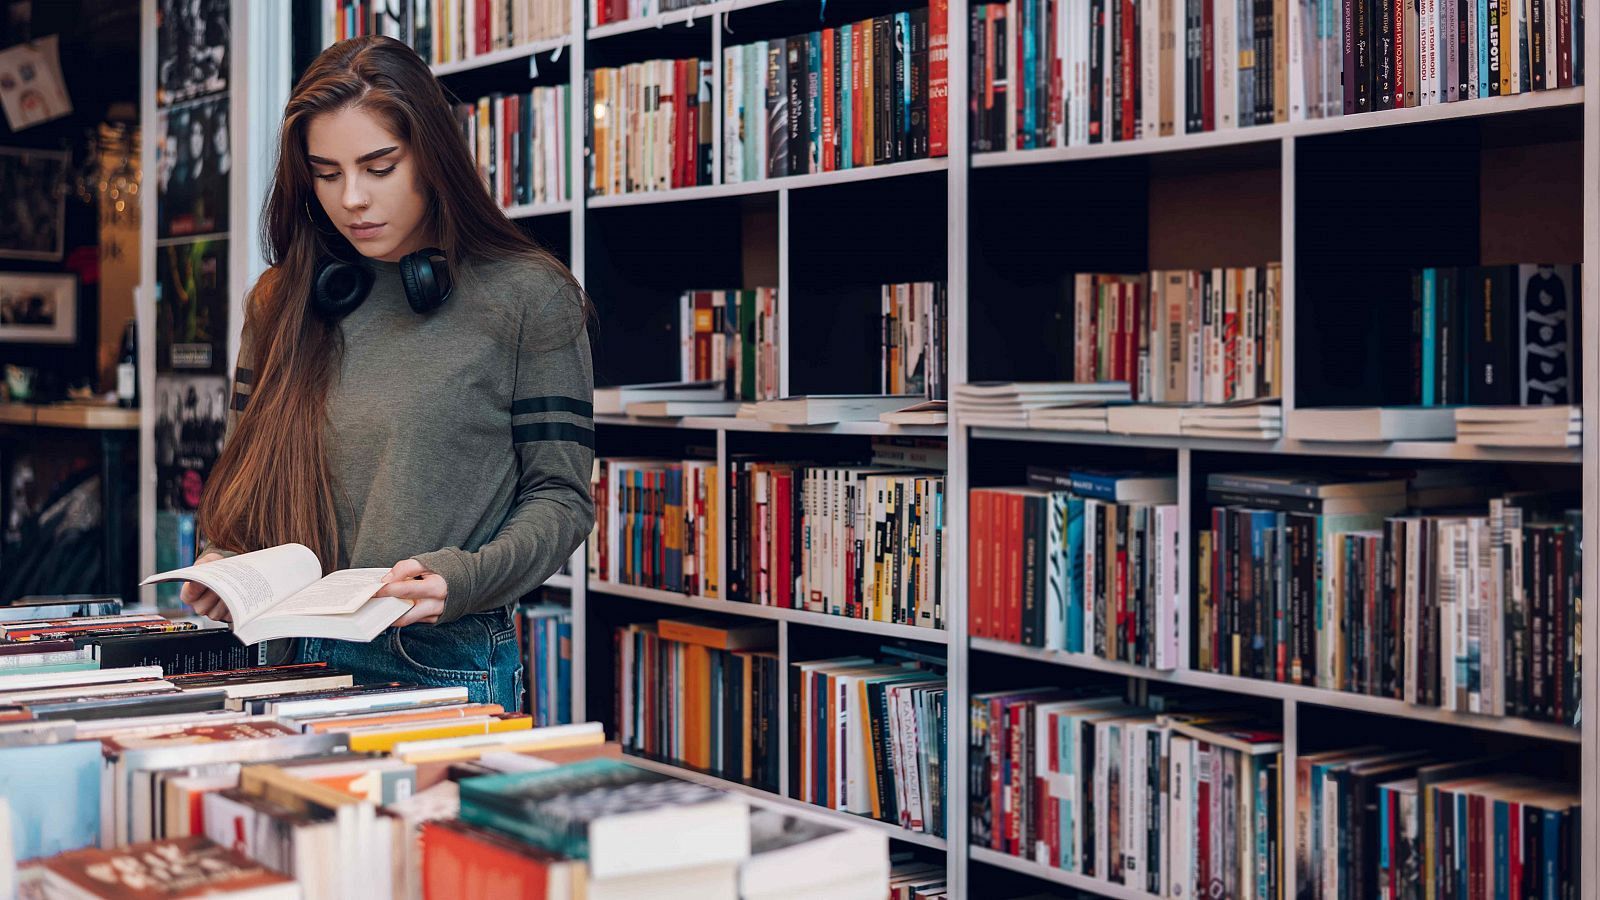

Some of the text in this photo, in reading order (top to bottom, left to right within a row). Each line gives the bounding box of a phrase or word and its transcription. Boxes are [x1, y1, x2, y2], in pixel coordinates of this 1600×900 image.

[1396, 34, 1402, 43] ИЗ
[1490, 25, 1498, 71] LEPOTU
[903, 701, 914, 760] KATARINA
